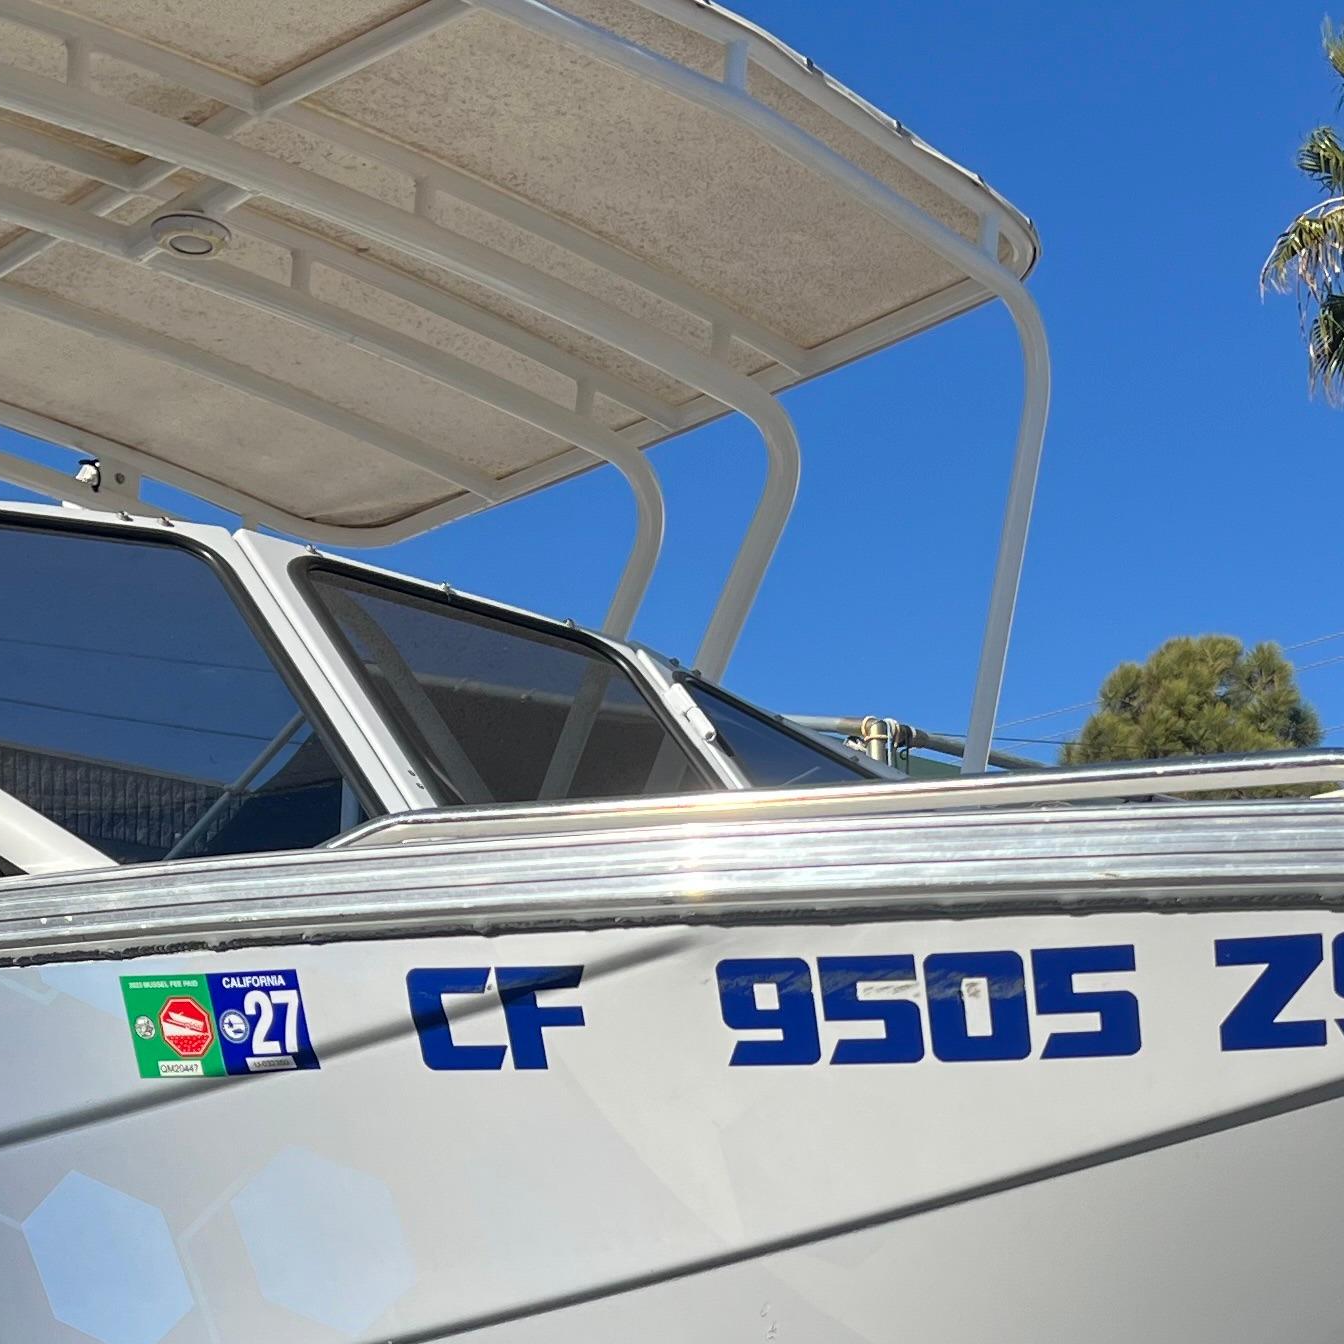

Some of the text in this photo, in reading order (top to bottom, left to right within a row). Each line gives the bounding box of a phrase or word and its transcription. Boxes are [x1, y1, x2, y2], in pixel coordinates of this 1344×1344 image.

[222, 974, 286, 989] CALIFORNIA
[406, 965, 586, 1070] CF
[716, 944, 1142, 1067] 9505
[243, 989, 299, 1055] 27
